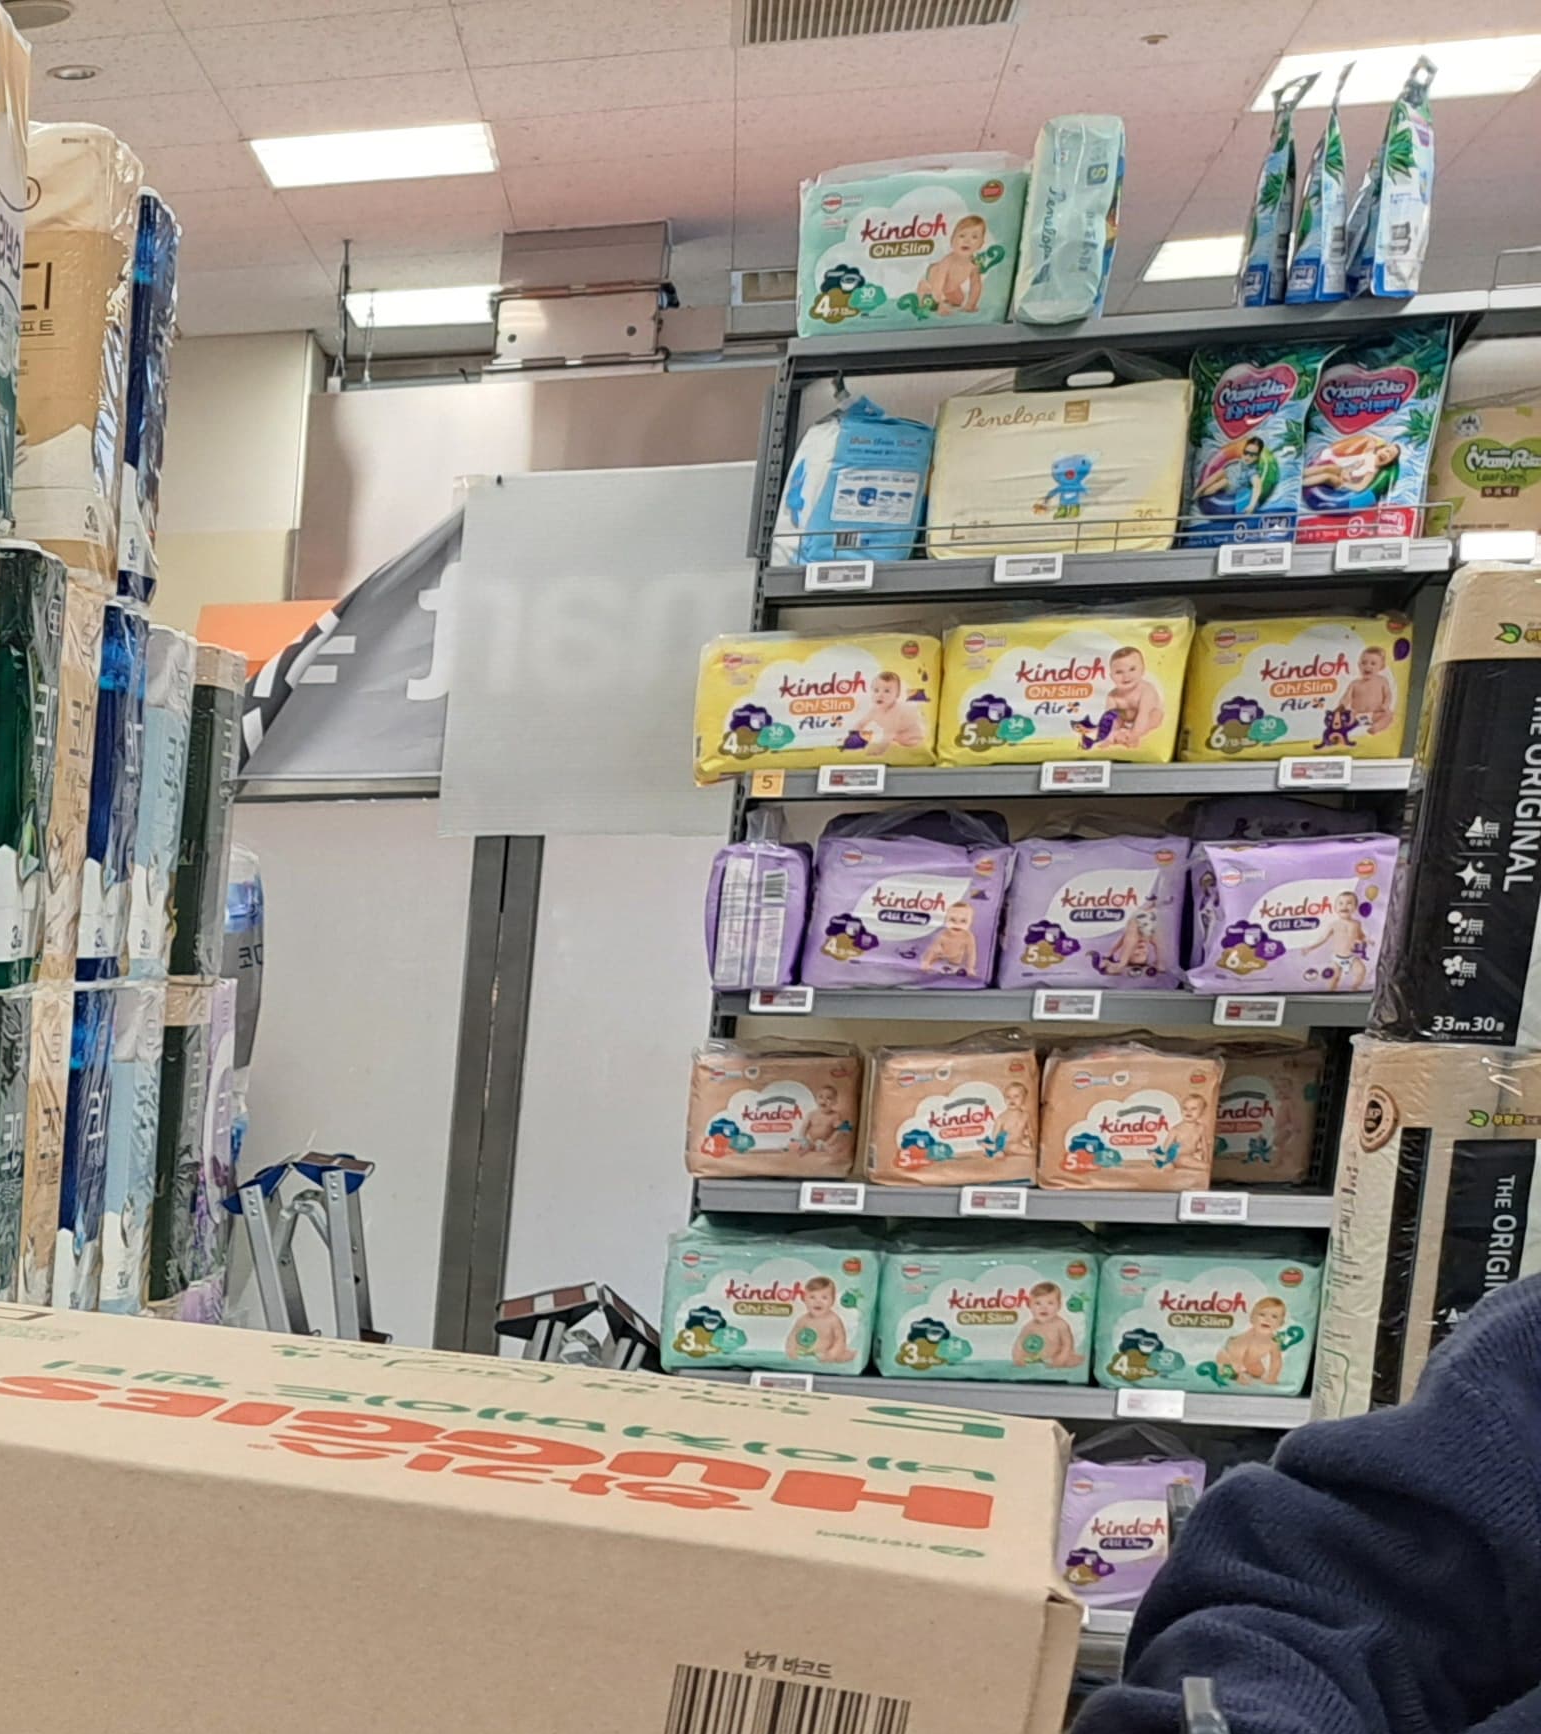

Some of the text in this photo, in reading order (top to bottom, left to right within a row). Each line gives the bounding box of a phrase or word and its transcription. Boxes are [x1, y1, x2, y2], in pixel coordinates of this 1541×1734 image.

[860, 212, 948, 243] kindoh
[872, 241, 933, 258] Oh! Slim
[1321, 378, 1407, 402] MamyPoko
[960, 404, 1057, 430] Penelope
[1015, 656, 1107, 685] kindoh
[1260, 653, 1350, 681] kindoh
[778, 671, 868, 699] kindoh
[1028, 684, 1090, 699] Oh! Slim
[1273, 680, 1334, 697] Oh! Slim
[792, 699, 852, 714] Oh! Slim
[1034, 700, 1066, 715] Air
[1279, 697, 1310, 713] Air
[798, 715, 830, 731] Air
[1210, 726, 1227, 750] 6
[761, 775, 773, 791] 5
[871, 886, 947, 913] kindoh
[1060, 887, 1139, 909] kindoh
[1258, 896, 1334, 919] kindoh
[1025, 946, 1039, 965] 5
[1224, 950, 1239, 969] 6
[1430, 1015, 1471, 1032] 33m
[740, 1104, 804, 1122] kindoh
[927, 1105, 996, 1129] kindoh
[1099, 1114, 1170, 1135] kindoh
[1493, 1174, 1517, 1210] THE
[724, 1278, 807, 1303] kindoh
[947, 1287, 1032, 1311] kindoh
[1157, 1288, 1248, 1314] kindoh
[1170, 1314, 1232, 1327] Oh! Slim
[680, 1332, 696, 1352] 3
[903, 1341, 919, 1362] 3
[1090, 1516, 1167, 1539] kindoh
[782, 1657, 834, 1680] 바코드
